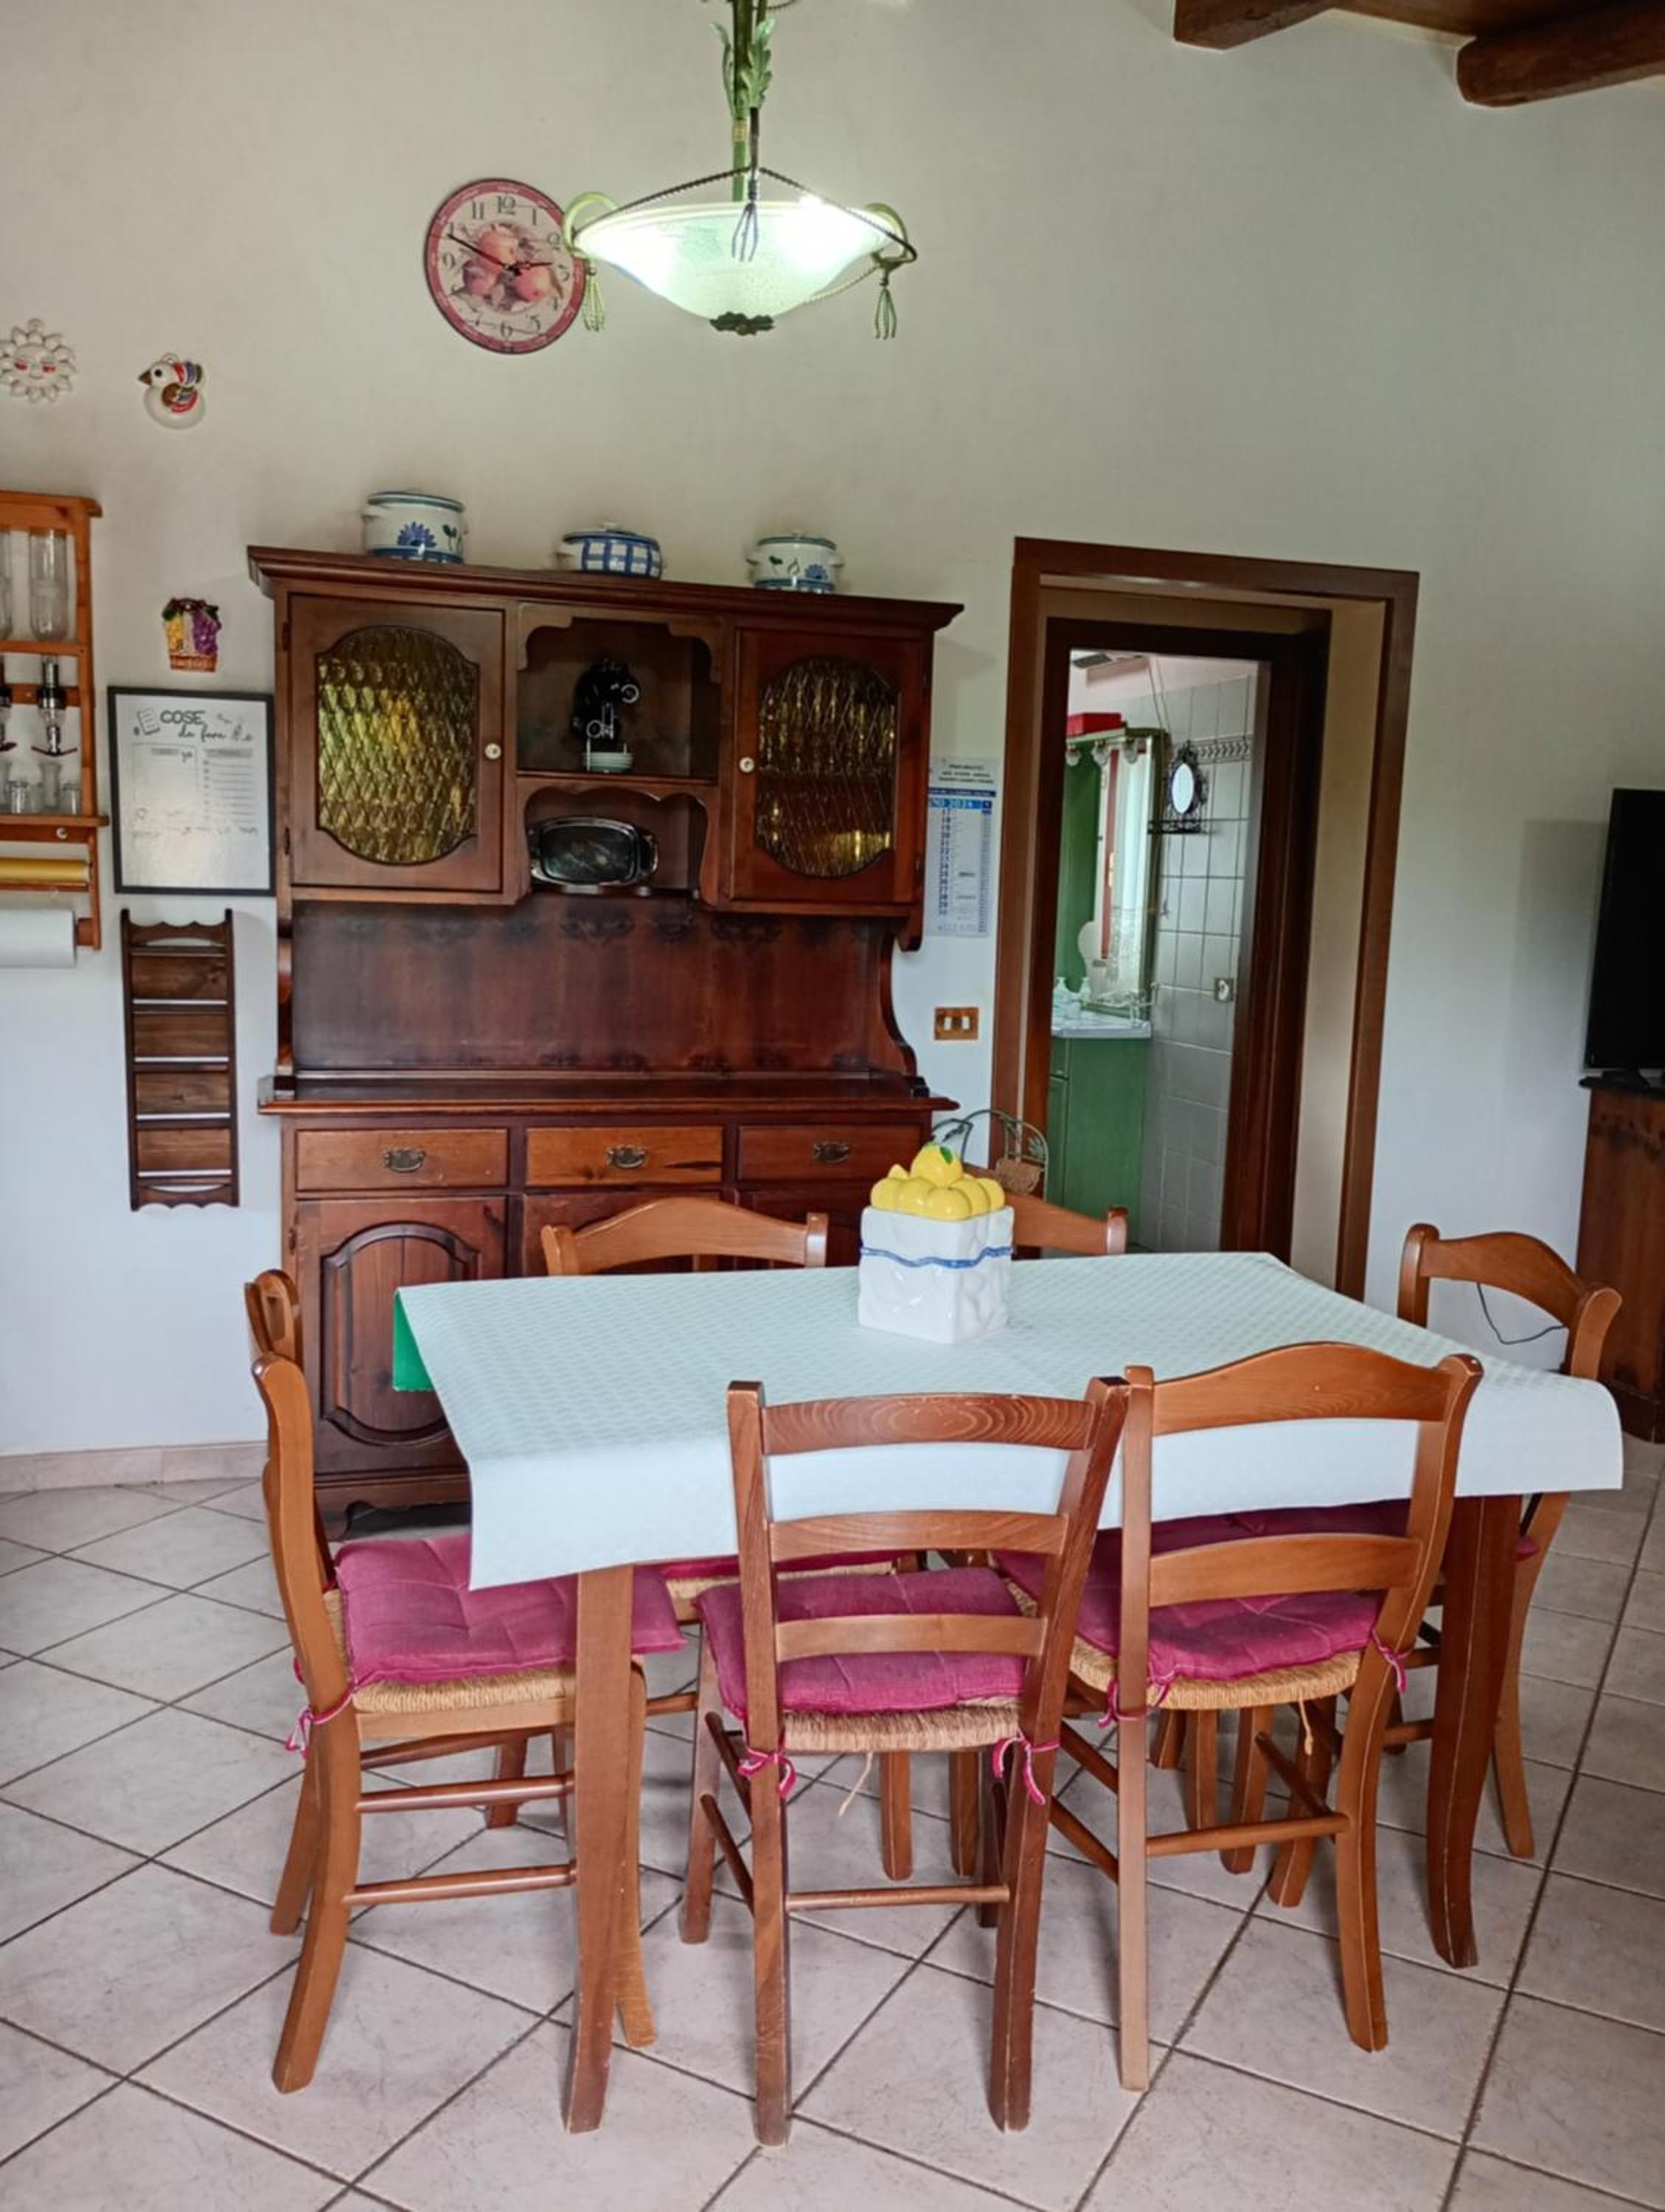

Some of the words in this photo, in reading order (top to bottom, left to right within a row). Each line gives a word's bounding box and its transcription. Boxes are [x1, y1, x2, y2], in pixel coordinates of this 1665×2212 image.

[472, 201, 484, 220] 11
[497, 195, 516, 215] 12
[532, 207, 538, 226] 1
[546, 231, 561, 250] 2
[442, 253, 456, 271] 9
[499, 321, 513, 338] 6
[160, 709, 206, 726] COSE
